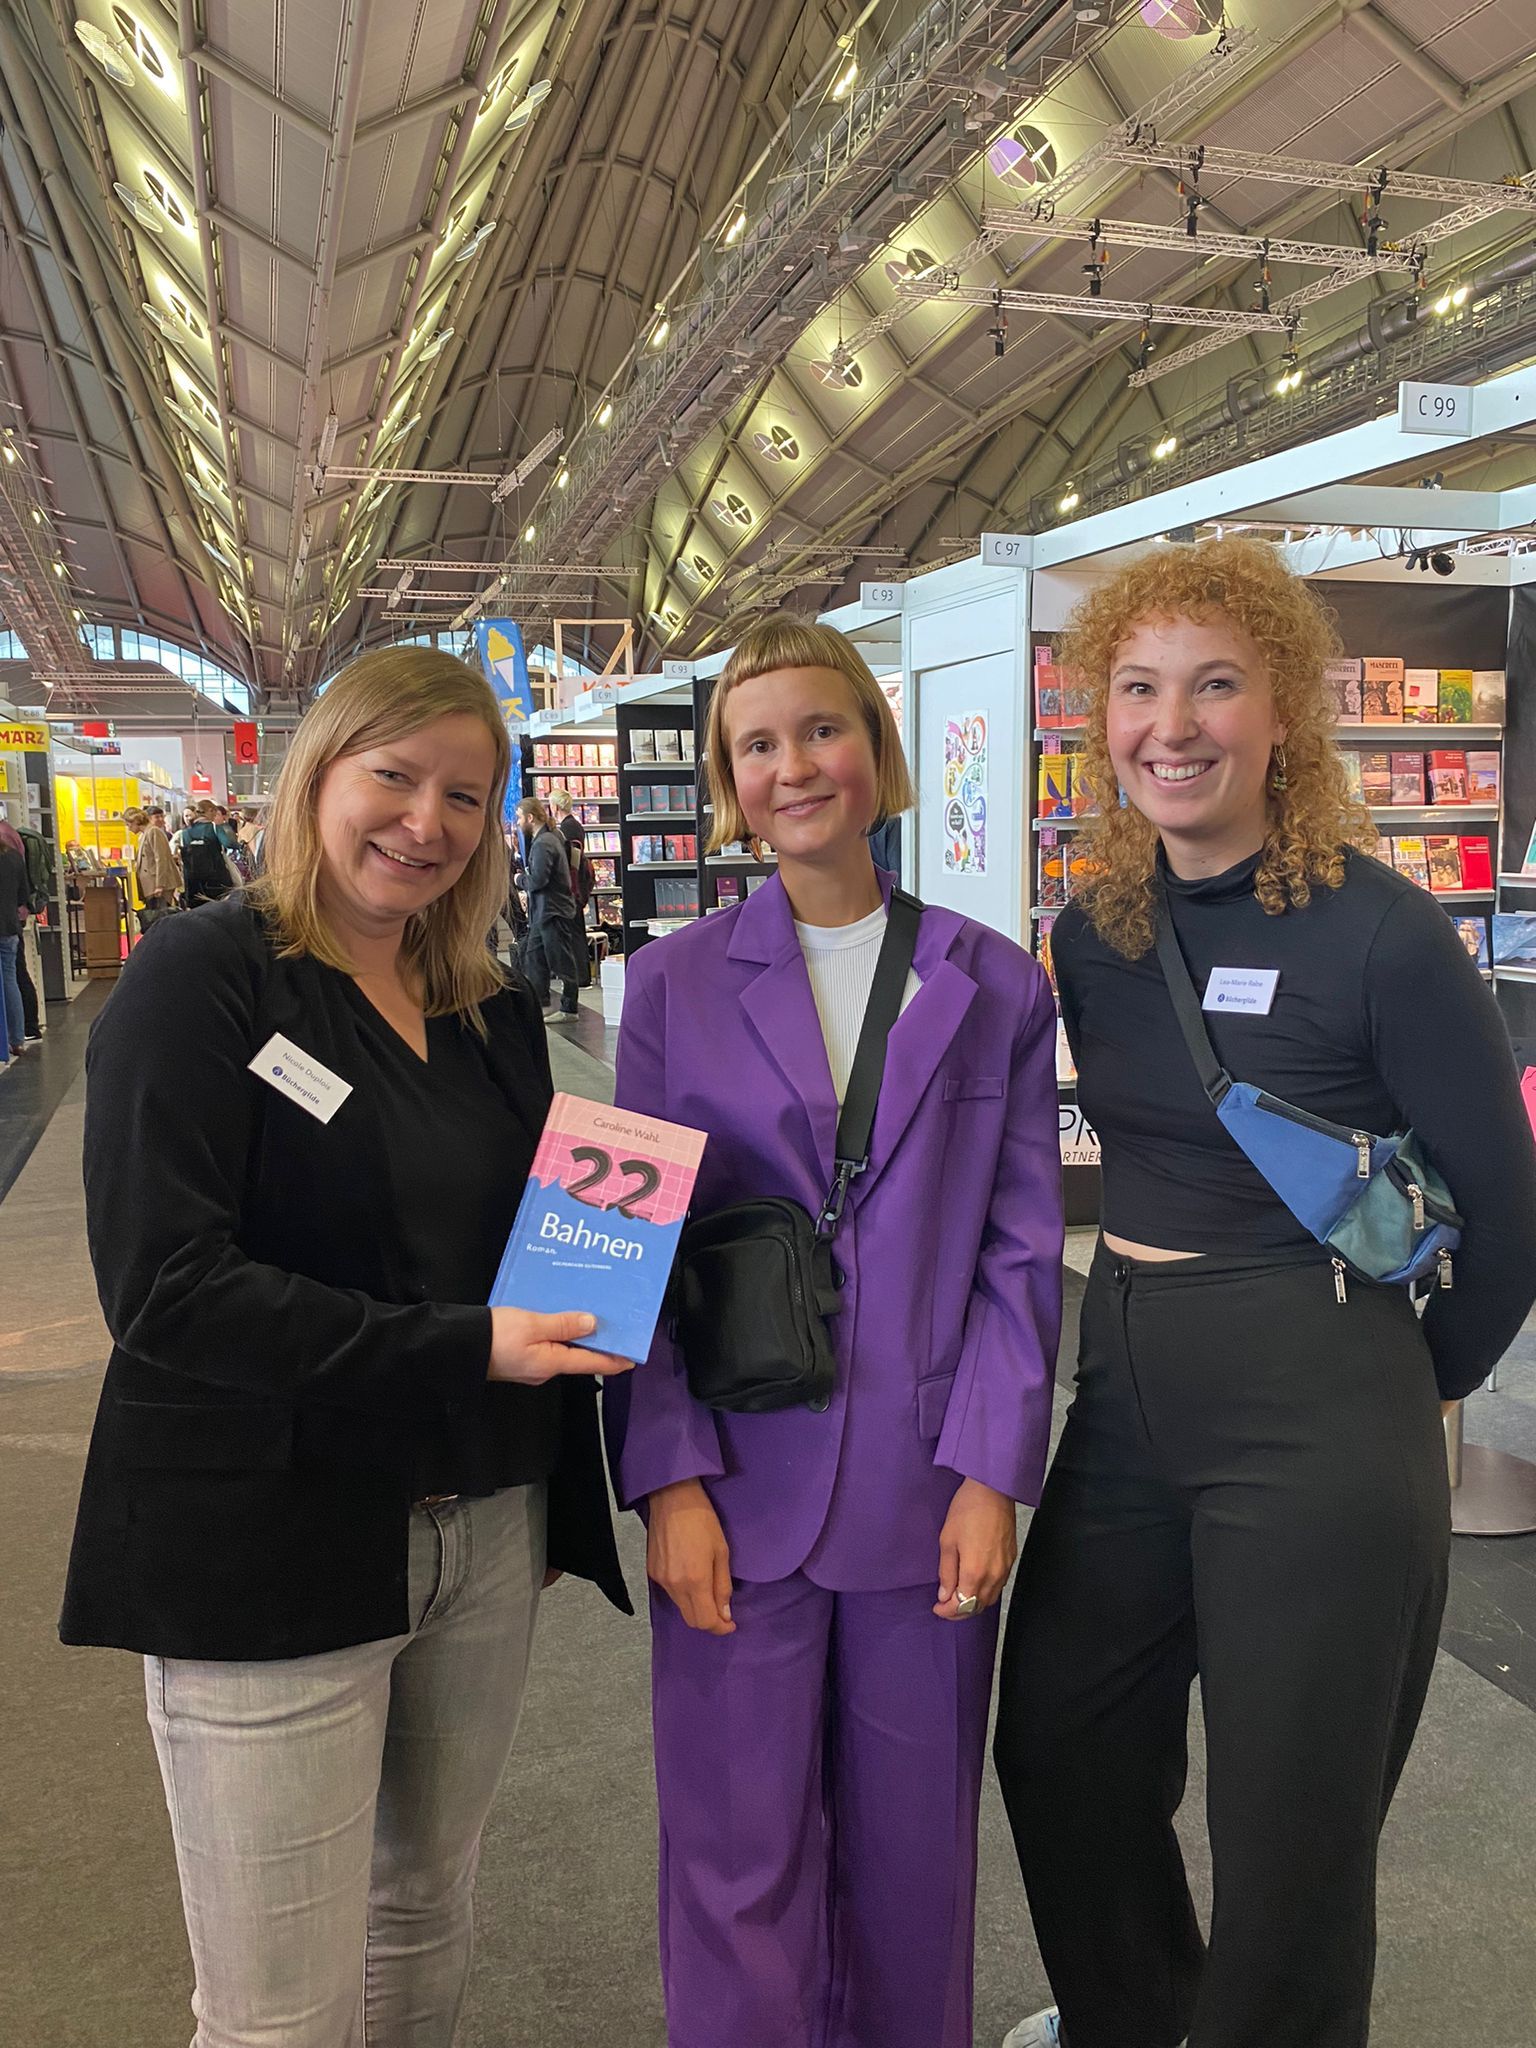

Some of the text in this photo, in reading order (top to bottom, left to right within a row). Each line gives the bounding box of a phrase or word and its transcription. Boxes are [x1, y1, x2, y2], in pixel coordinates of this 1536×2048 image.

[1419, 394, 1456, 418] C 99
[994, 541, 1020, 556] C 97
[871, 588, 894, 602] C 93
[671, 664, 688, 674] C 93
[0, 730, 45, 745] MÄRZ
[241, 741, 253, 758] C
[282, 1052, 305, 1071] Nicole
[281, 1073, 320, 1105] Büchergilde
[592, 1117, 661, 1144] Caroline Wahl
[566, 1145, 662, 1221] 22
[539, 1211, 644, 1261] Bahnen
